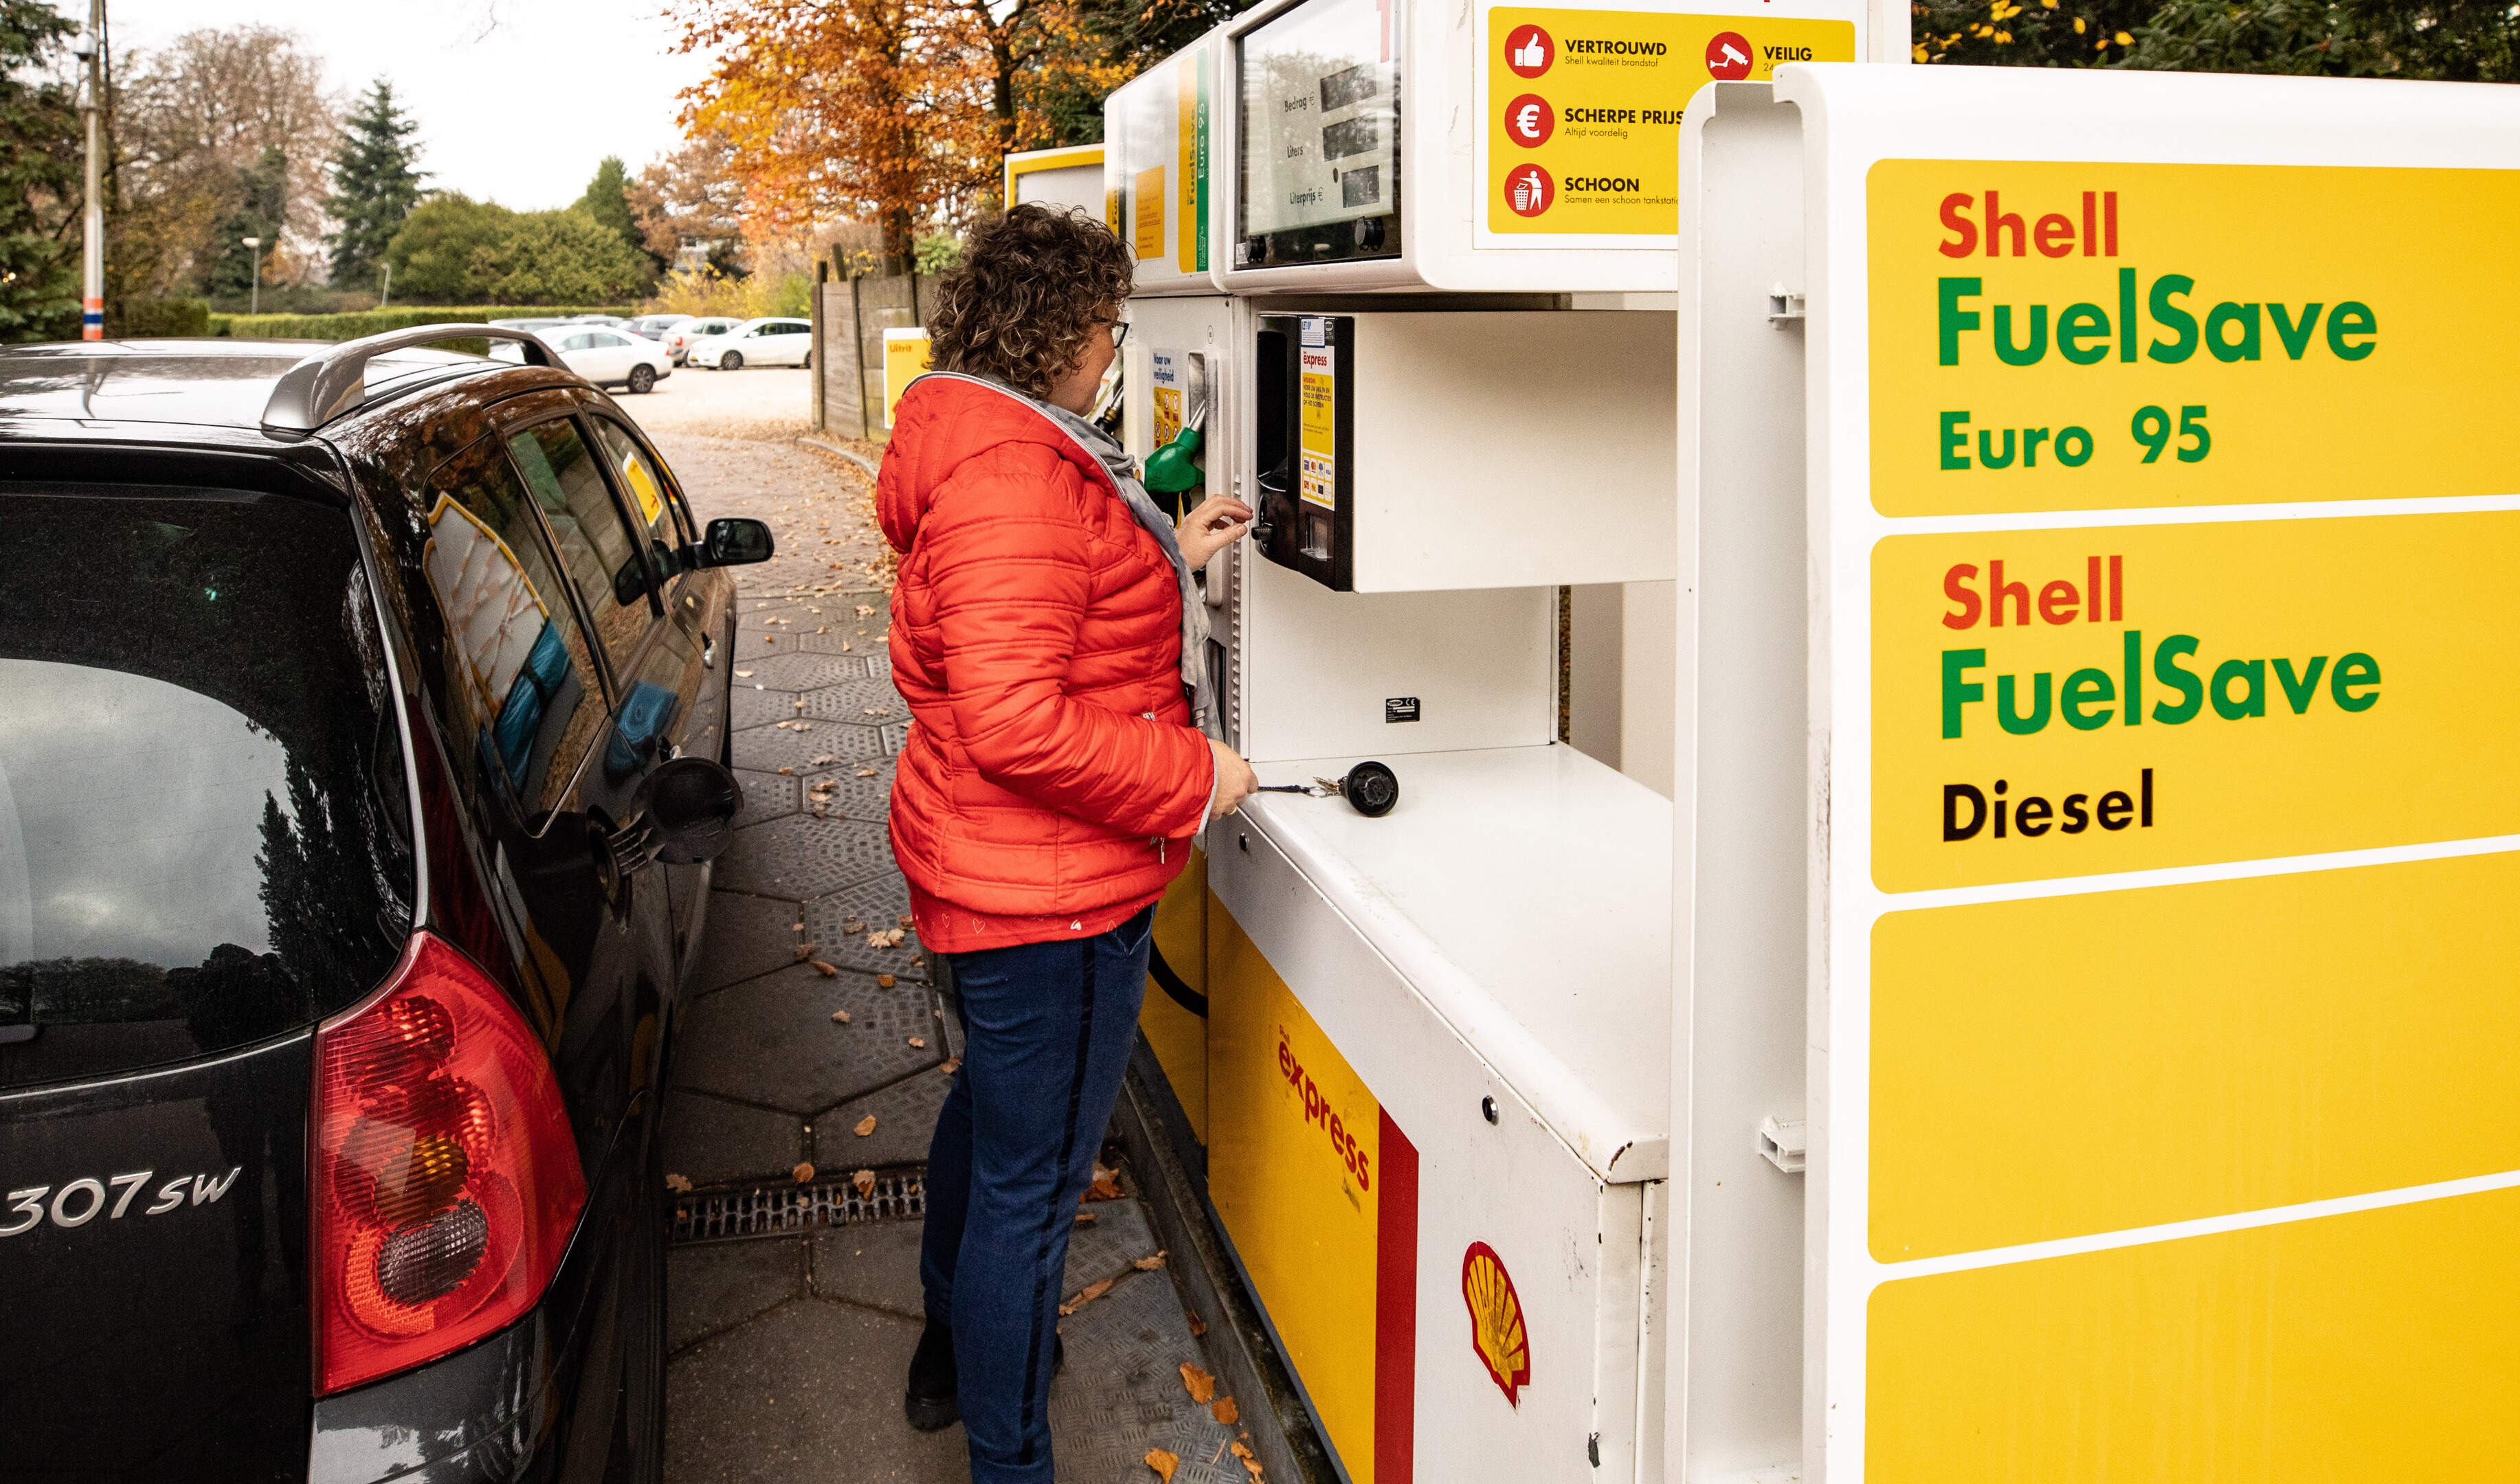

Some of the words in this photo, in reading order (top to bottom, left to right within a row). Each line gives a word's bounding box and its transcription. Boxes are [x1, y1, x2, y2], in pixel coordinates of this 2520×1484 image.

[1564, 39, 1667, 56] VERTROUWD
[1763, 45, 1813, 61] VEILIG
[1564, 56, 1584, 65] Shell
[1586, 56, 1619, 67] kwaliteit
[1621, 57, 1659, 67] brandstof
[1284, 96, 1307, 113] Bedrag
[1198, 102, 1205, 129] 95
[1565, 108, 1636, 124] SCHERPE
[1642, 110, 1684, 125] PRIJS
[1564, 127, 1586, 138] Altijd
[1589, 128, 1628, 139] voordelig
[1286, 144, 1304, 158] Liters
[1565, 177, 1640, 192] SCHOON
[1290, 188, 1316, 206] Literprijs
[1564, 194, 1592, 203] Samen
[1612, 195, 1641, 204] schoon
[1939, 190, 2117, 258] Shell
[1938, 267, 2377, 366] FuelSave
[889, 344, 912, 352] Uitrit
[1153, 352, 1163, 366] Voor
[1163, 356, 1172, 366] uw
[1303, 355, 1327, 369] express
[1940, 411, 2093, 470] Euro
[2131, 405, 2211, 464] 95
[1942, 555, 2122, 630] Shell
[1942, 630, 2380, 739] FuelSave
[1943, 768, 2152, 842] Diesel
[1278, 1041, 1370, 1193] express
[0, 1171, 153, 1237] 307
[145, 1167, 242, 1215] SW
